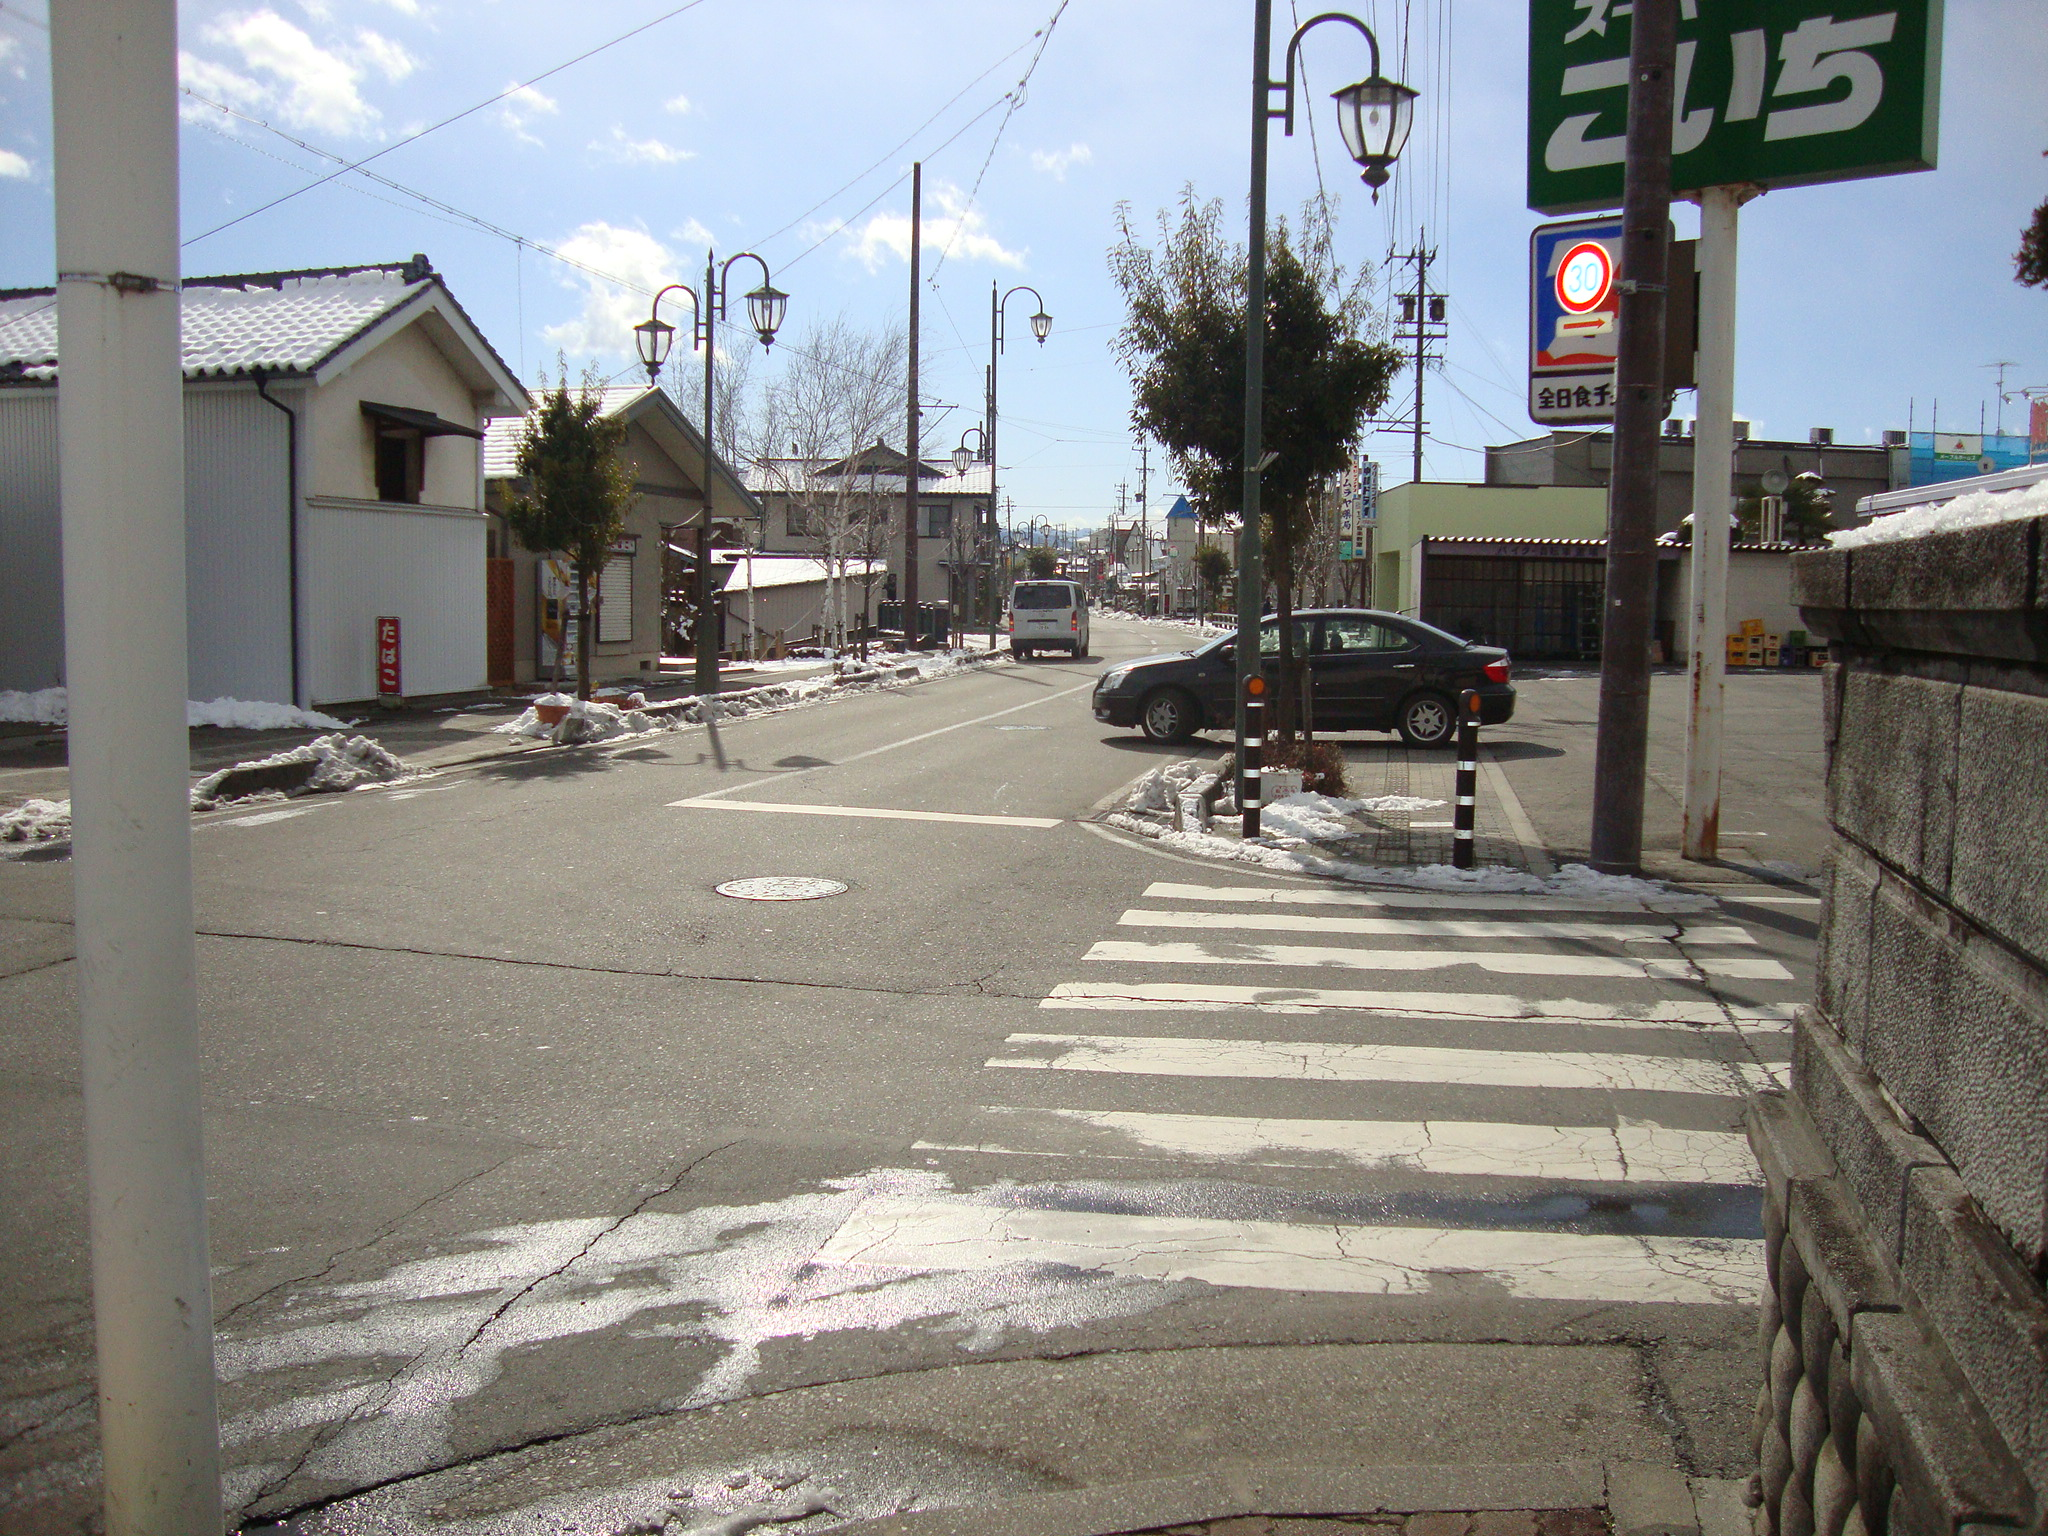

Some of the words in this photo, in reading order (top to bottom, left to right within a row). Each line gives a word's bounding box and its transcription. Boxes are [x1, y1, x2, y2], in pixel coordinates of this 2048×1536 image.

[1569, 262, 1598, 293] 30
[1538, 383, 1617, 409] 全日食チ
[382, 622, 396, 686] たばこ
